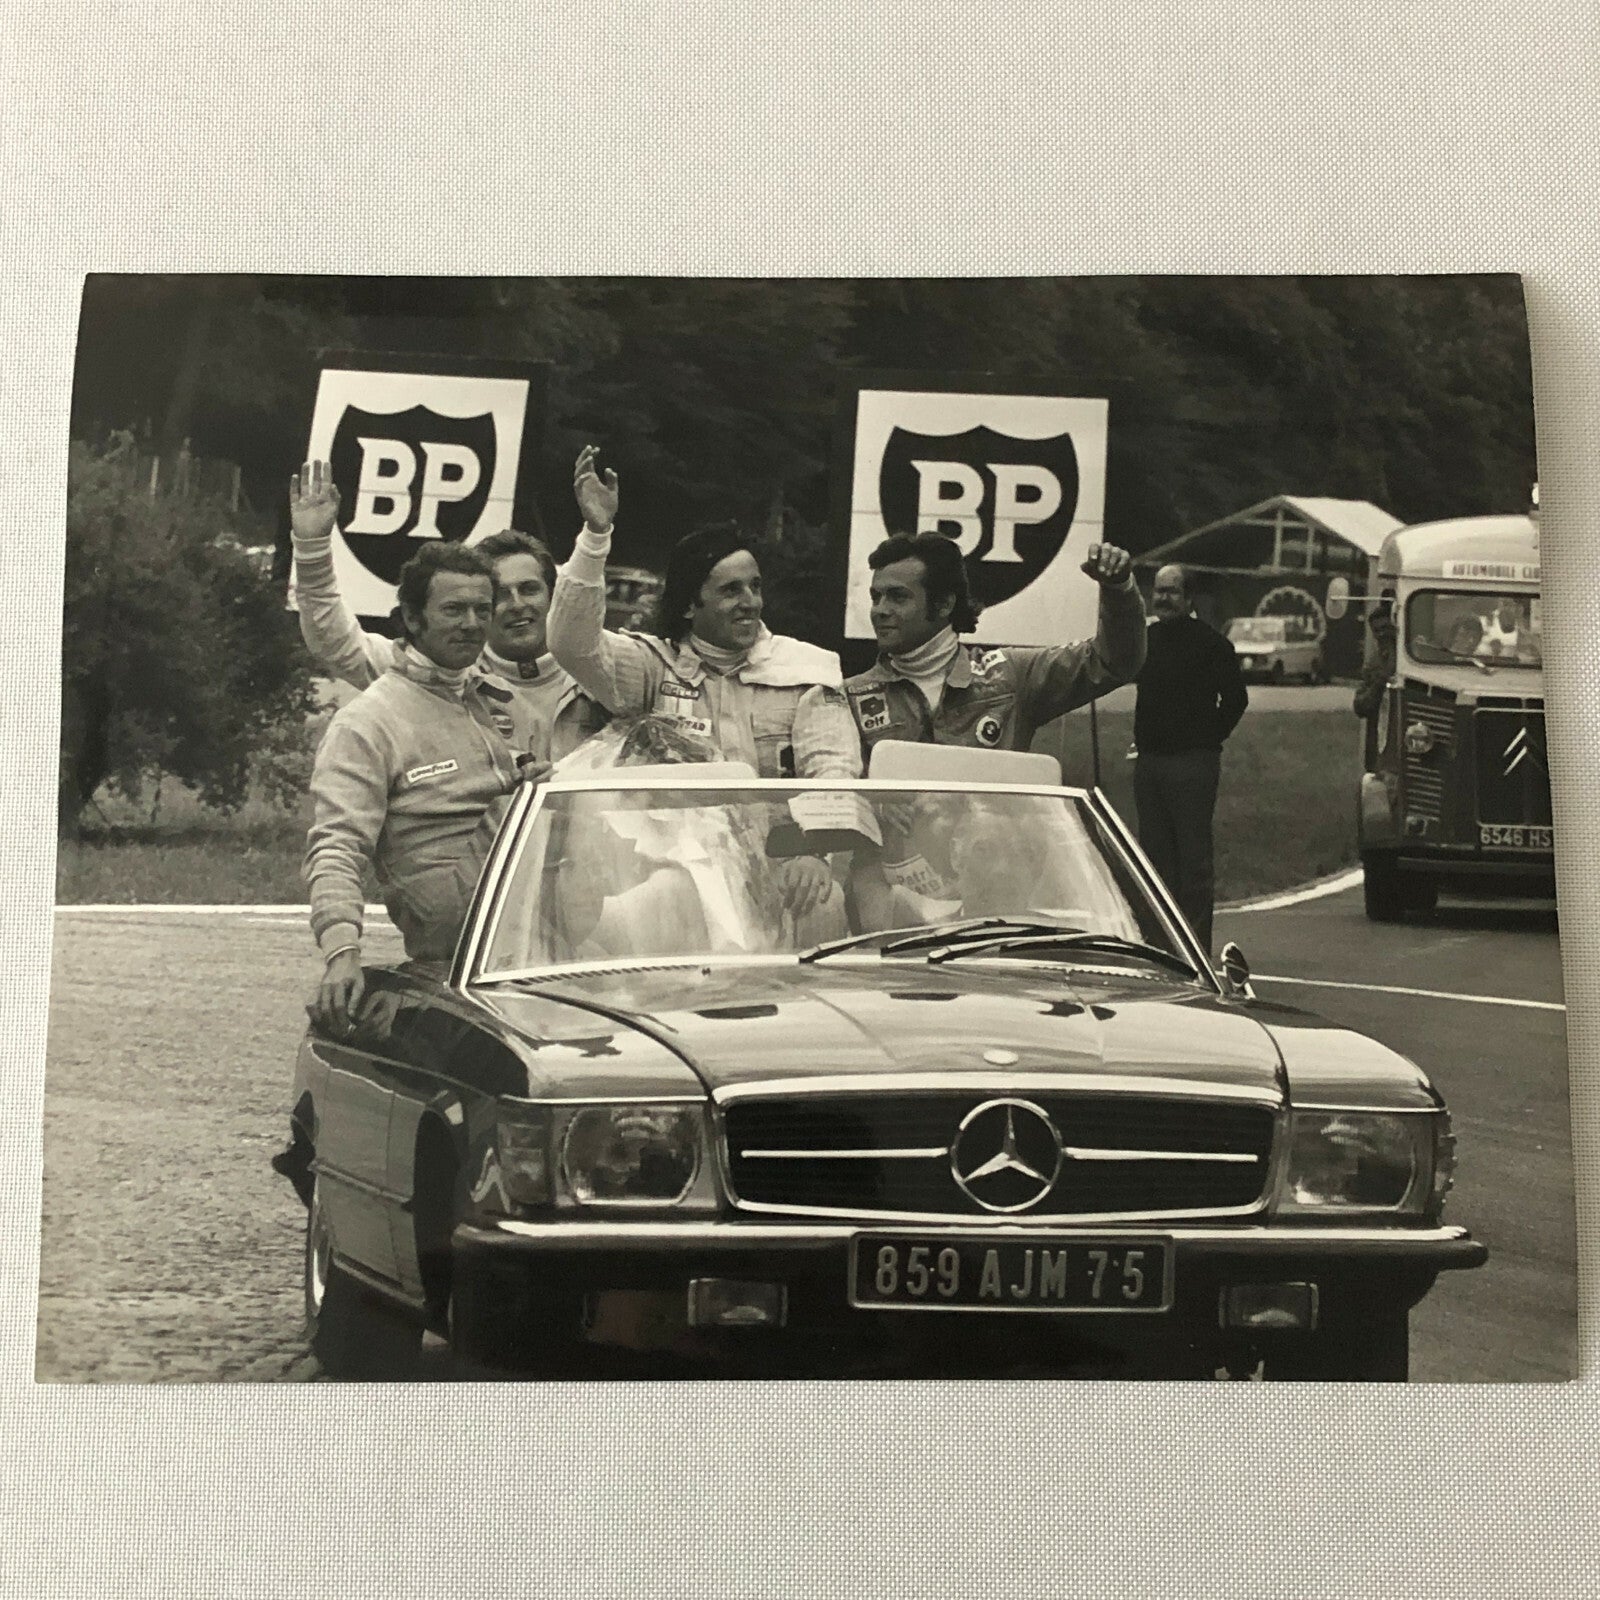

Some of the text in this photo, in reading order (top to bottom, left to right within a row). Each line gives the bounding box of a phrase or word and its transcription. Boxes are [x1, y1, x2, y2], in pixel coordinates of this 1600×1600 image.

[344, 437, 482, 539] BP
[910, 460, 1062, 562] BP
[1452, 563, 1516, 578] AUTOMOBILE
[864, 715, 885, 729] elf
[1481, 827, 1552, 847] 6546 HS
[875, 1245, 1145, 1300] 859 AJM 75
